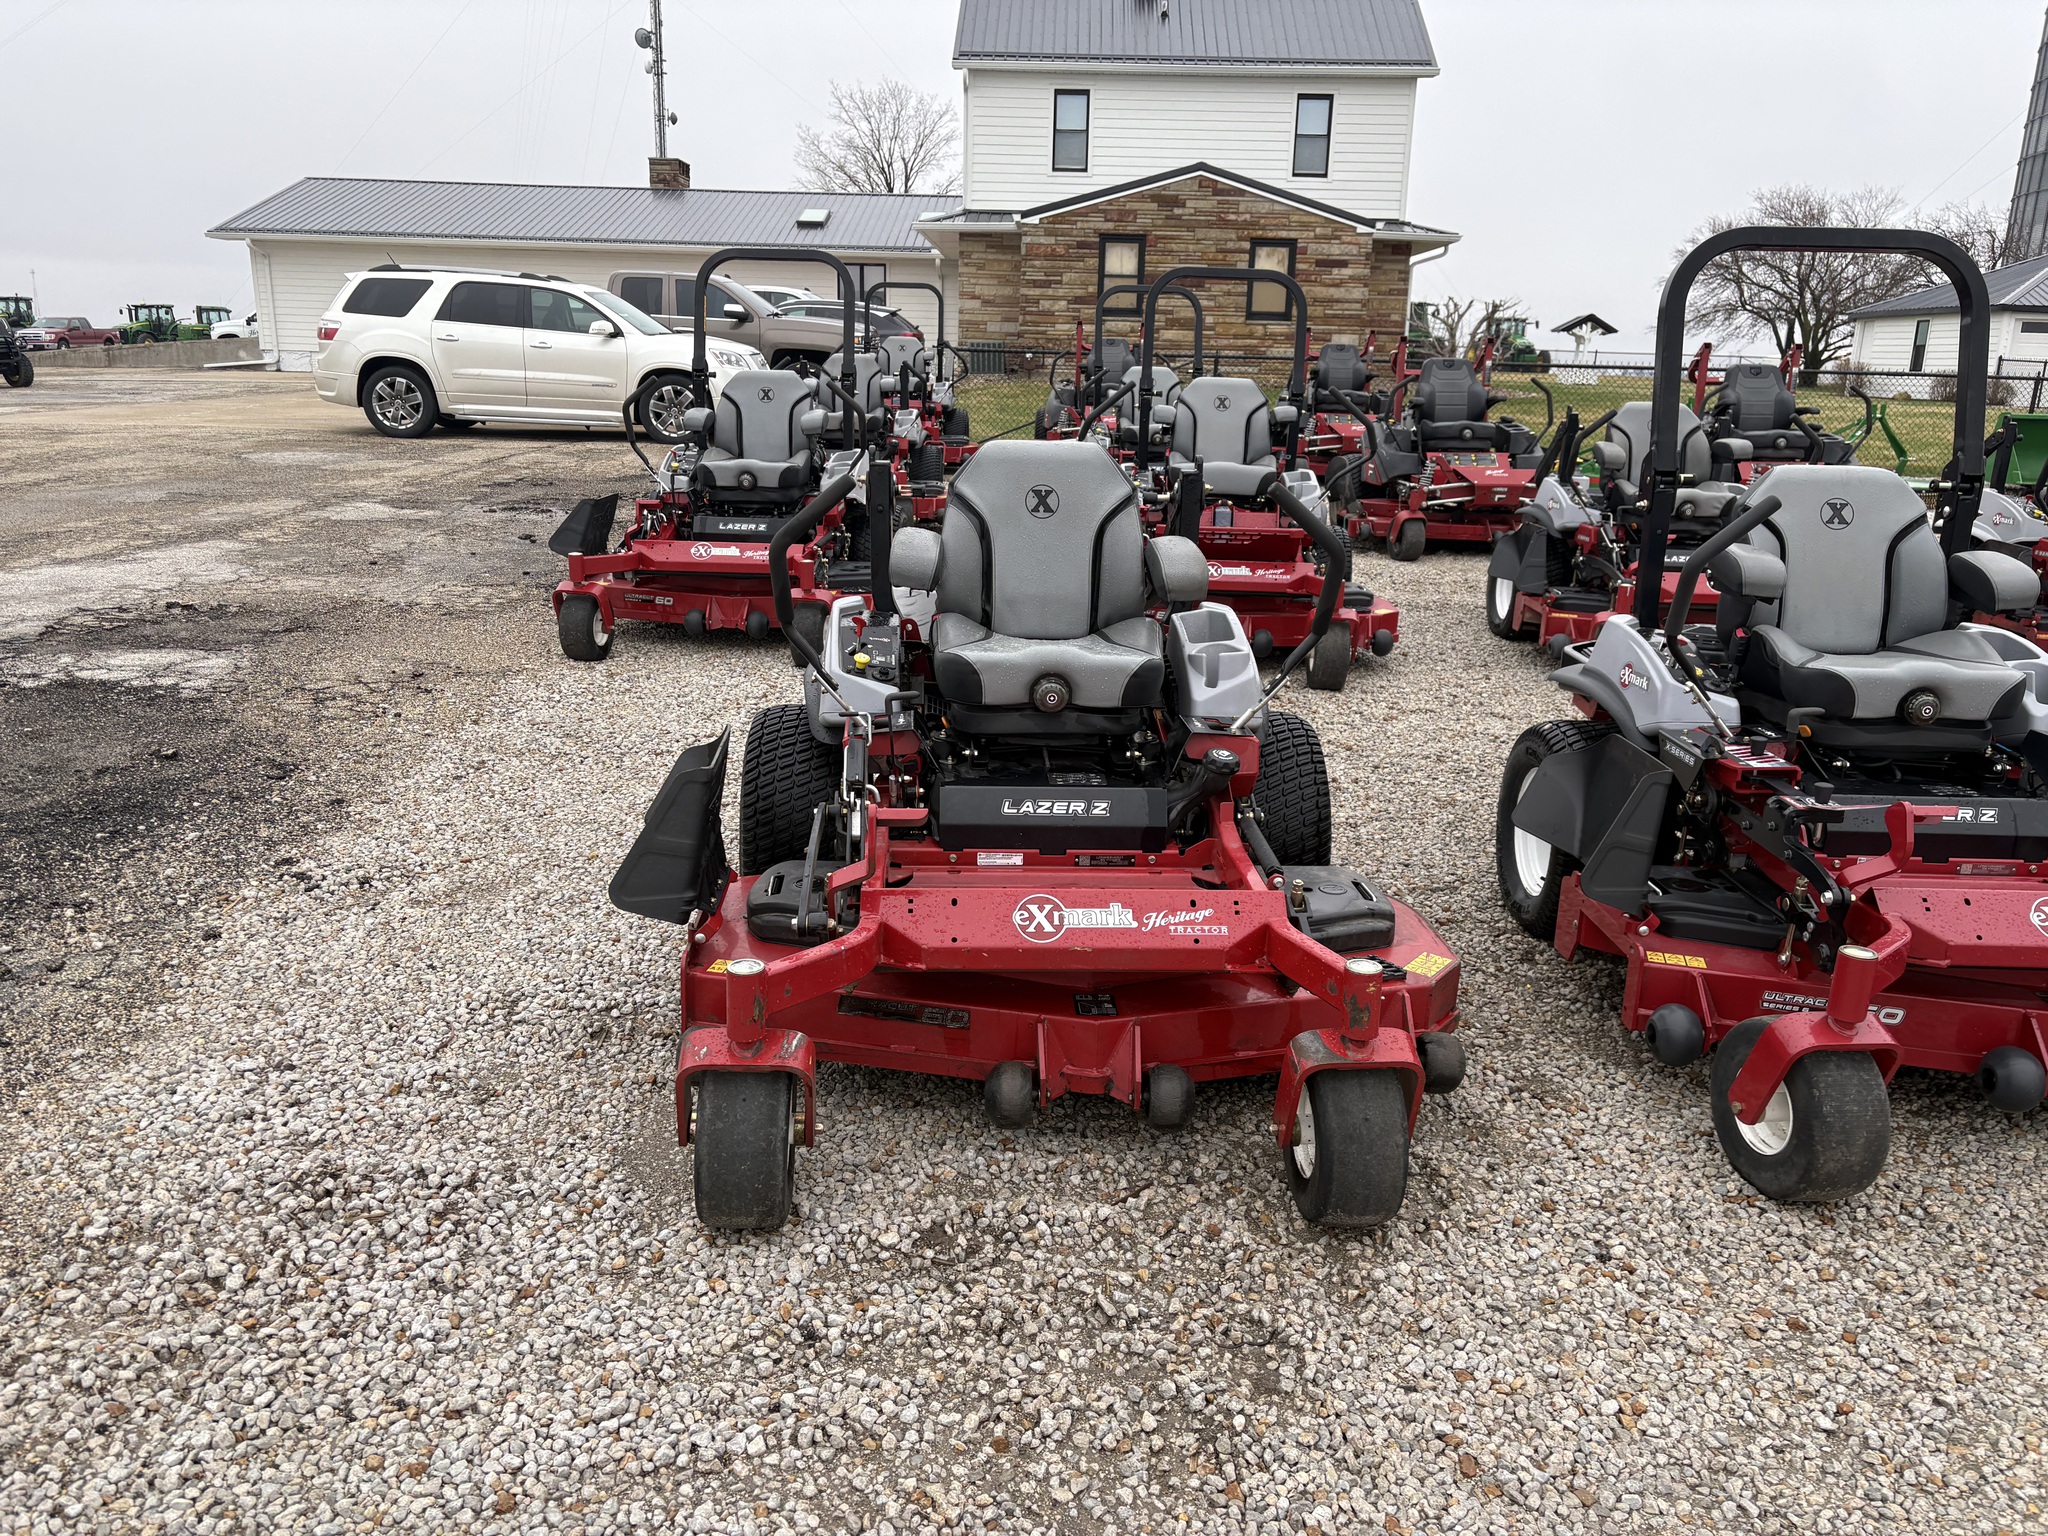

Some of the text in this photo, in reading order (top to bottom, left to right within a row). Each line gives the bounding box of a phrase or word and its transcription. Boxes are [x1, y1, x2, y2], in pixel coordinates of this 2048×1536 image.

[759, 388, 773, 401] X
[1216, 397, 1229, 410] X
[1029, 488, 1056, 515] X
[1824, 501, 1850, 526] X
[718, 522, 768, 532] LAZER Z
[1664, 554, 1690, 562] LAZ
[1207, 564, 1252, 578] Xmark
[655, 596, 674, 606] 60
[1620, 666, 1649, 690] eXmark
[1664, 742, 1695, 766] X-SERIES
[1002, 800, 1110, 815] LAZER Z
[1979, 808, 1998, 822] Z
[1013, 898, 1215, 938] eXmark Heritage
[1169, 926, 1228, 935] TRACTOR
[1763, 991, 1828, 1007] ULTRAC
[1762, 1001, 1800, 1012] SERIES
